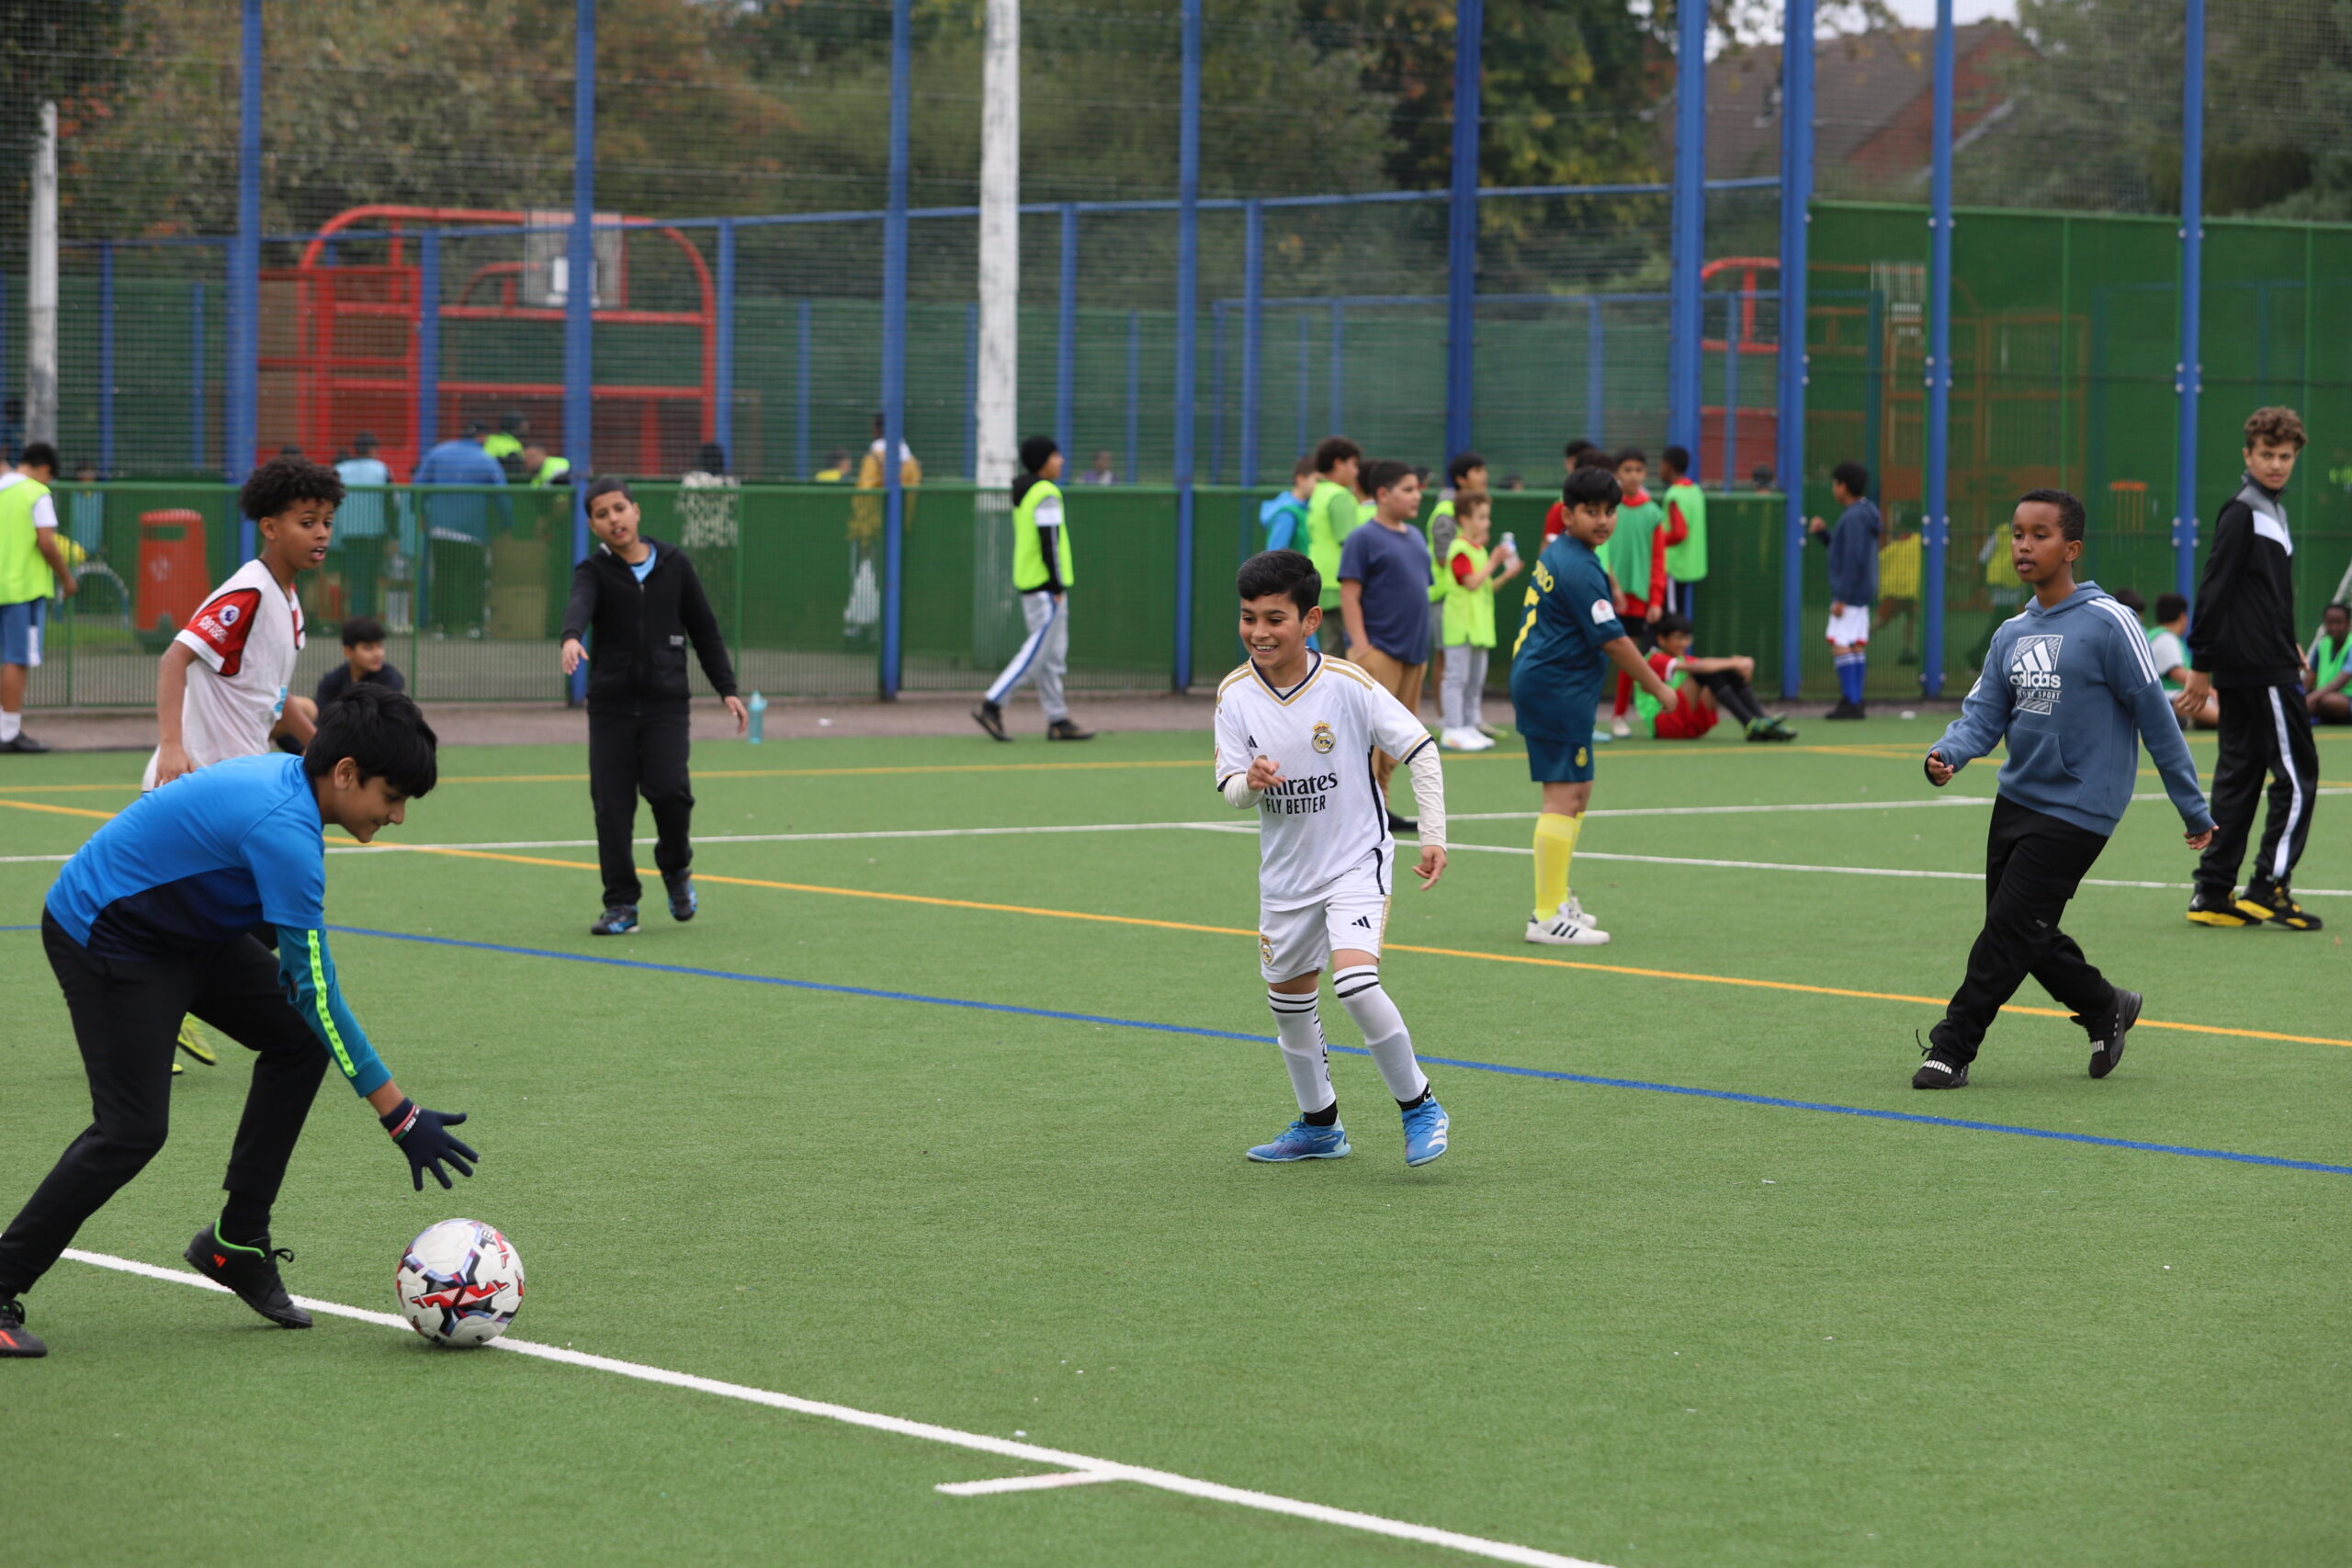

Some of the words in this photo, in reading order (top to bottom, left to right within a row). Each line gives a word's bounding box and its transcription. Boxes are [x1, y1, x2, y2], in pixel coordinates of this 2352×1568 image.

[2009, 670, 2062, 689] adidas
[2039, 691, 2061, 700] SPORT
[1264, 773, 1338, 796] mirates
[1265, 797, 1283, 815] FLY
[1286, 795, 1327, 815] BETTER
